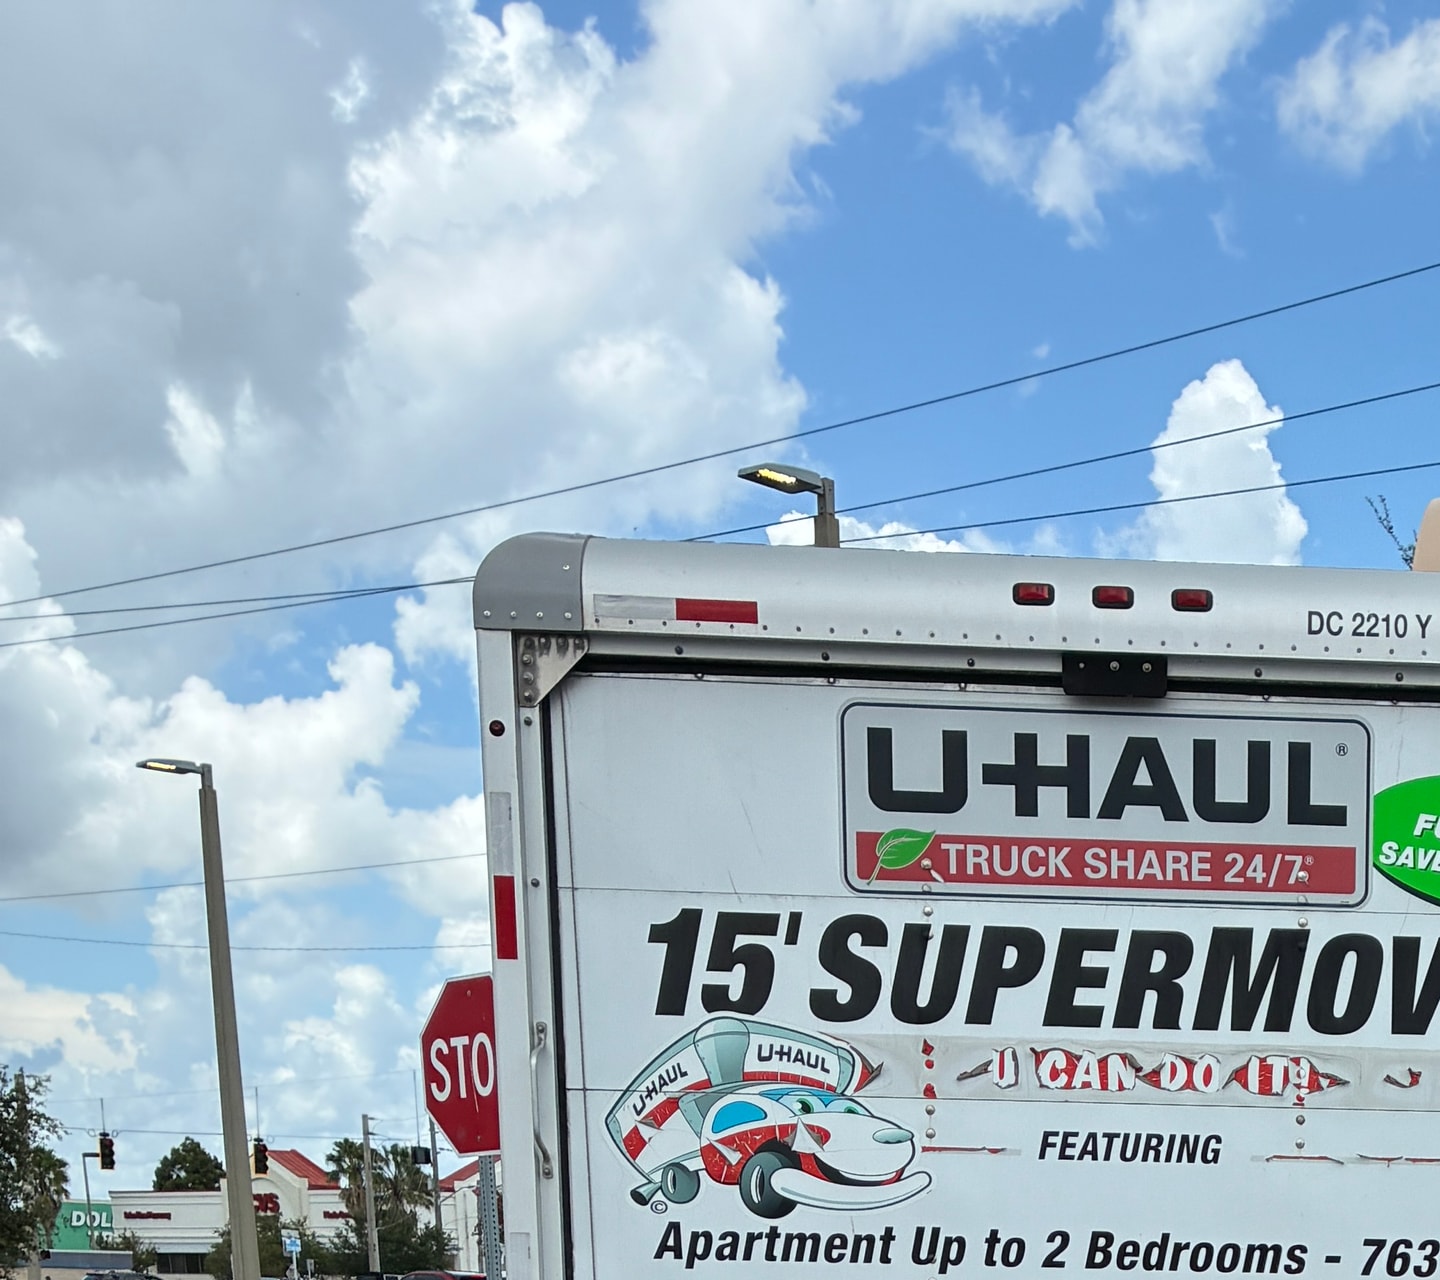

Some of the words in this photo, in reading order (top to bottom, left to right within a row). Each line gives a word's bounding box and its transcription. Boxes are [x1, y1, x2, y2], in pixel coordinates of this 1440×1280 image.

[1306, 610, 1344, 637] DC
[1351, 611, 1409, 640] 2210
[1413, 613, 1433, 641] Y
[867, 727, 1348, 827] U-HAUL
[941, 841, 1076, 879] TRUCK
[1083, 847, 1212, 883] SHARE
[1223, 852, 1304, 886] 24/7
[646, 907, 803, 1017] 15'
[756, 1043, 832, 1074] U-HAUL
[992, 1047, 1020, 1090] U
[1036, 1049, 1138, 1092] CAN
[1160, 1052, 1221, 1093] DO
[632, 1061, 690, 1117] U-HAUL
[1037, 1131, 1224, 1165] FEATURING
[71, 1210, 112, 1228] DOL
[653, 1221, 897, 1270] Apartment
[911, 1226, 967, 1275] Up
[984, 1231, 1027, 1269] to
[1041, 1229, 1071, 1269] 2
[1085, 1230, 1309, 1275] Bedrooms
